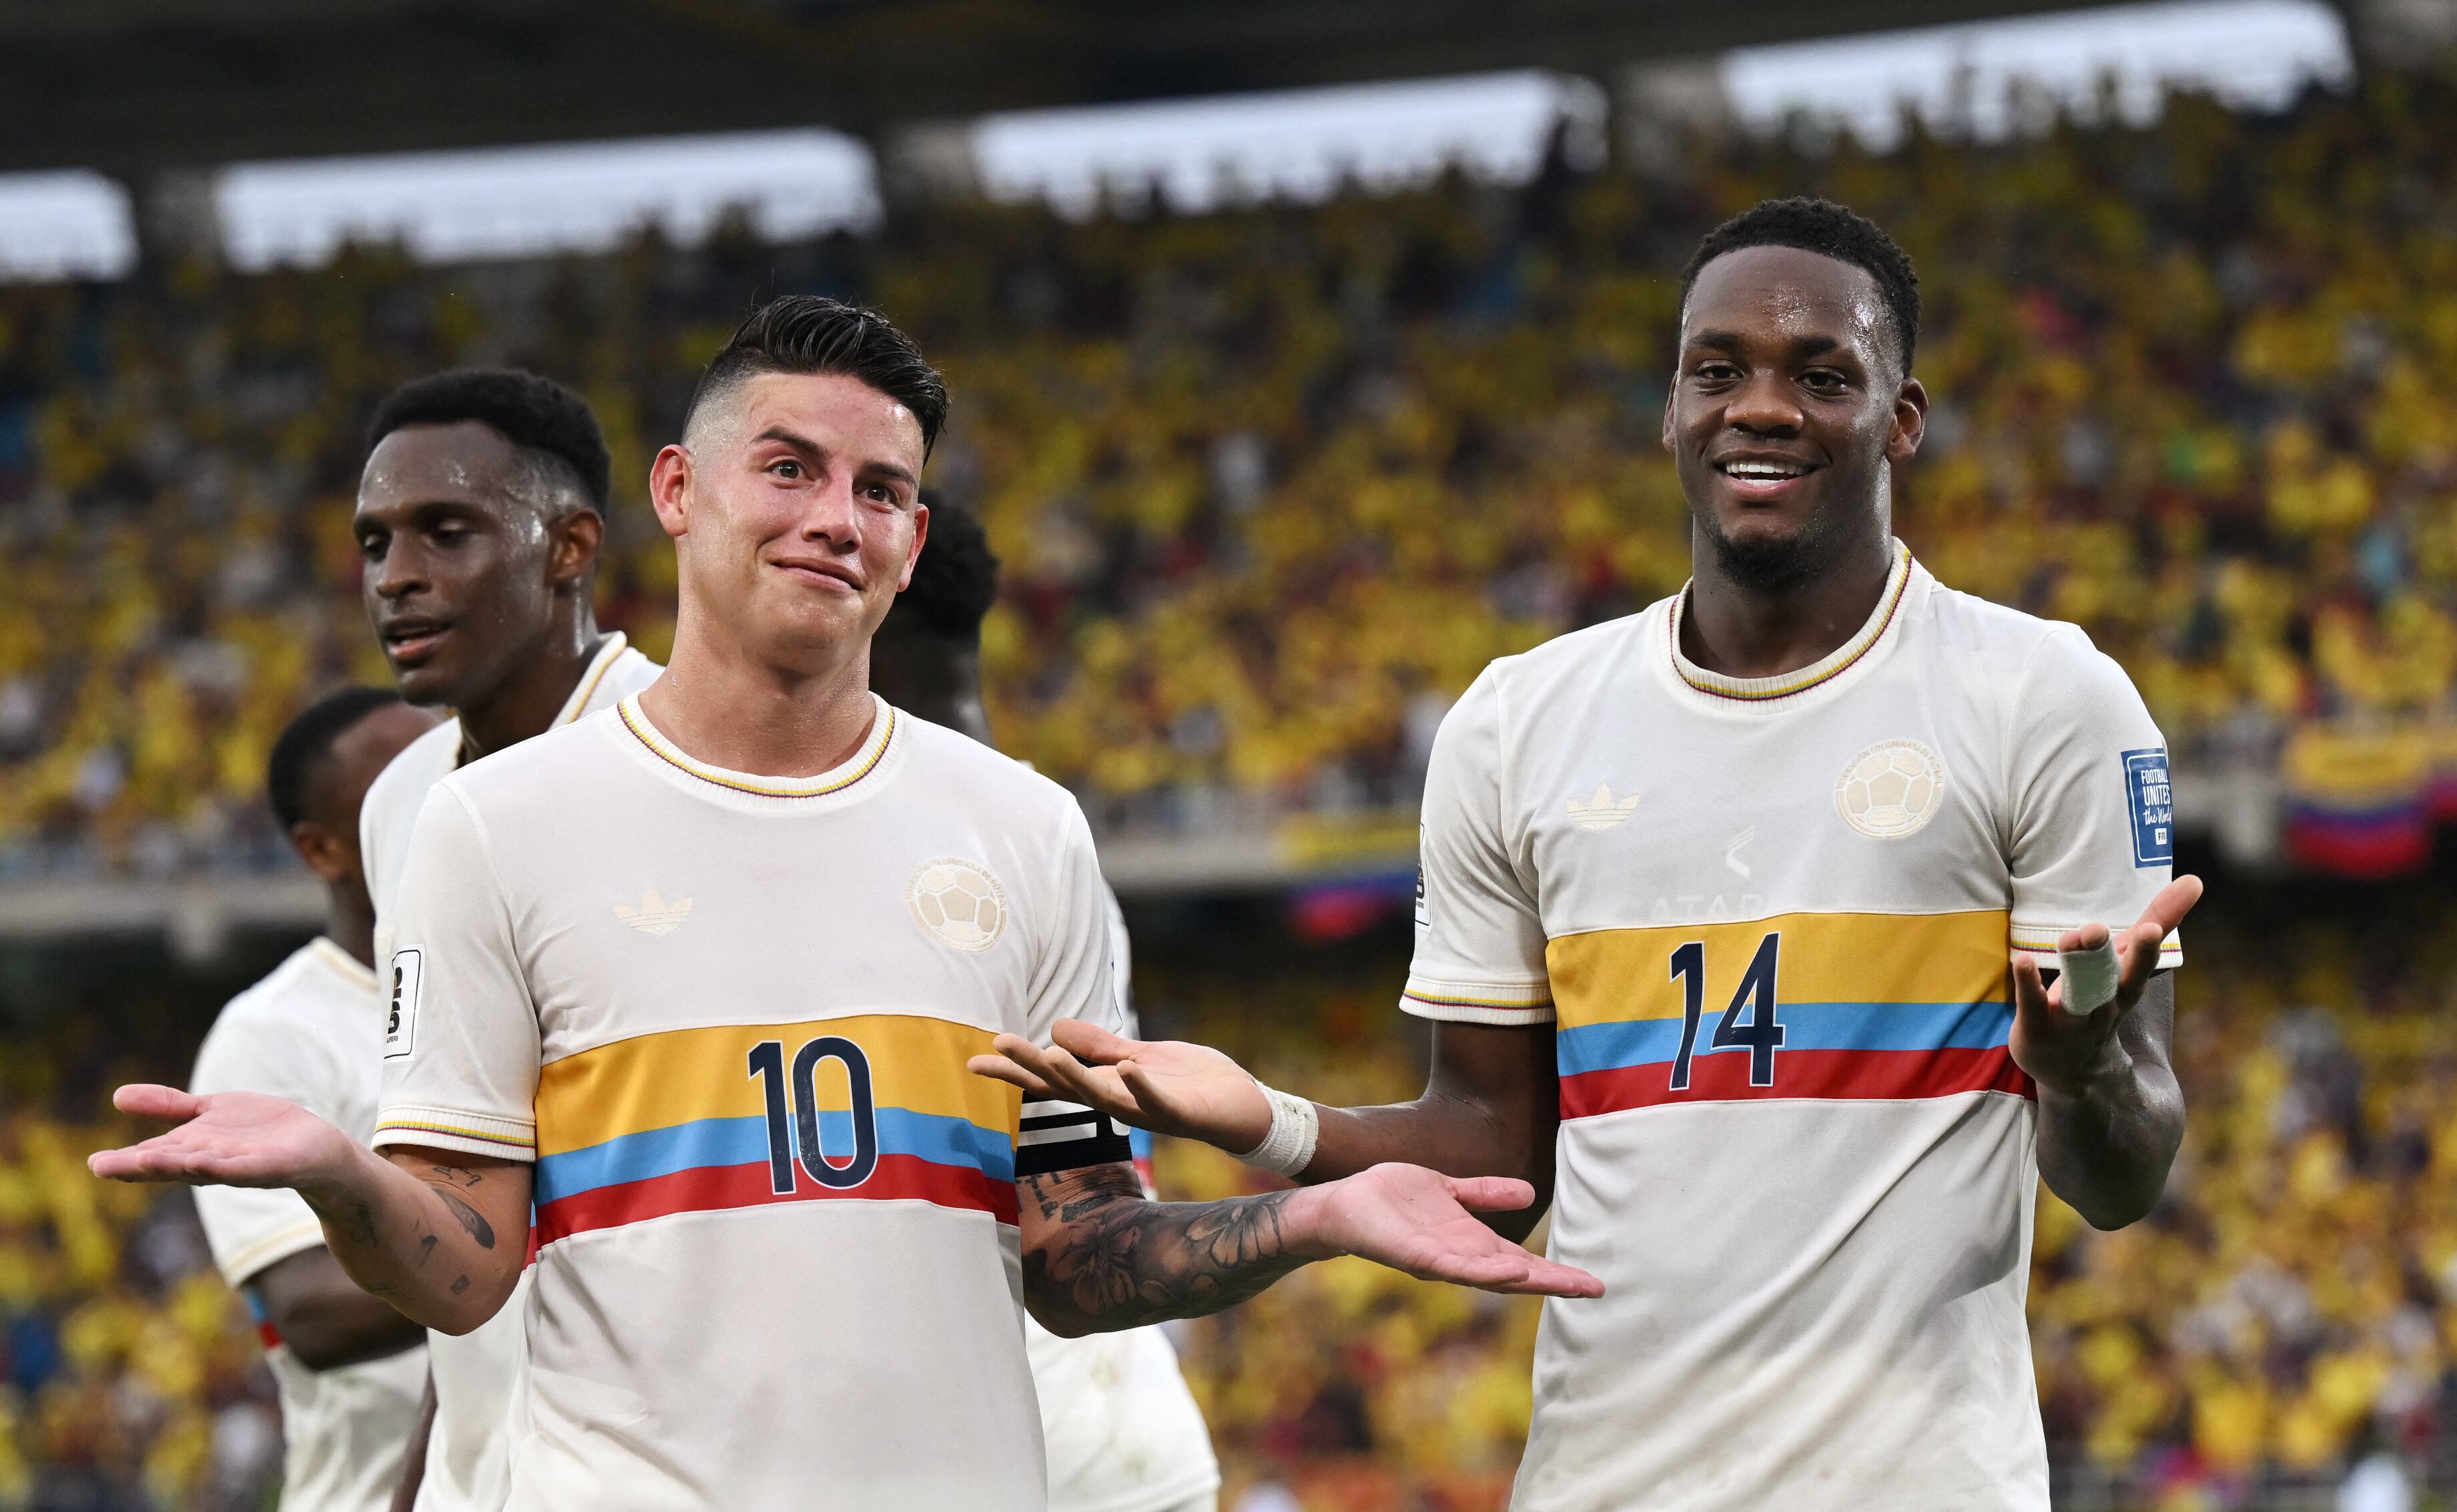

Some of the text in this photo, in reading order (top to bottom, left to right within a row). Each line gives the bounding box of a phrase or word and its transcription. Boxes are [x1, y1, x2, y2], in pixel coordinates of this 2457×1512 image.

[2141, 769, 2168, 785] FOOTBALL
[2143, 785, 2170, 806] UNITES
[2143, 805, 2172, 826] the World
[1669, 930, 1786, 1091] 14
[747, 1035, 879, 1195] 10
